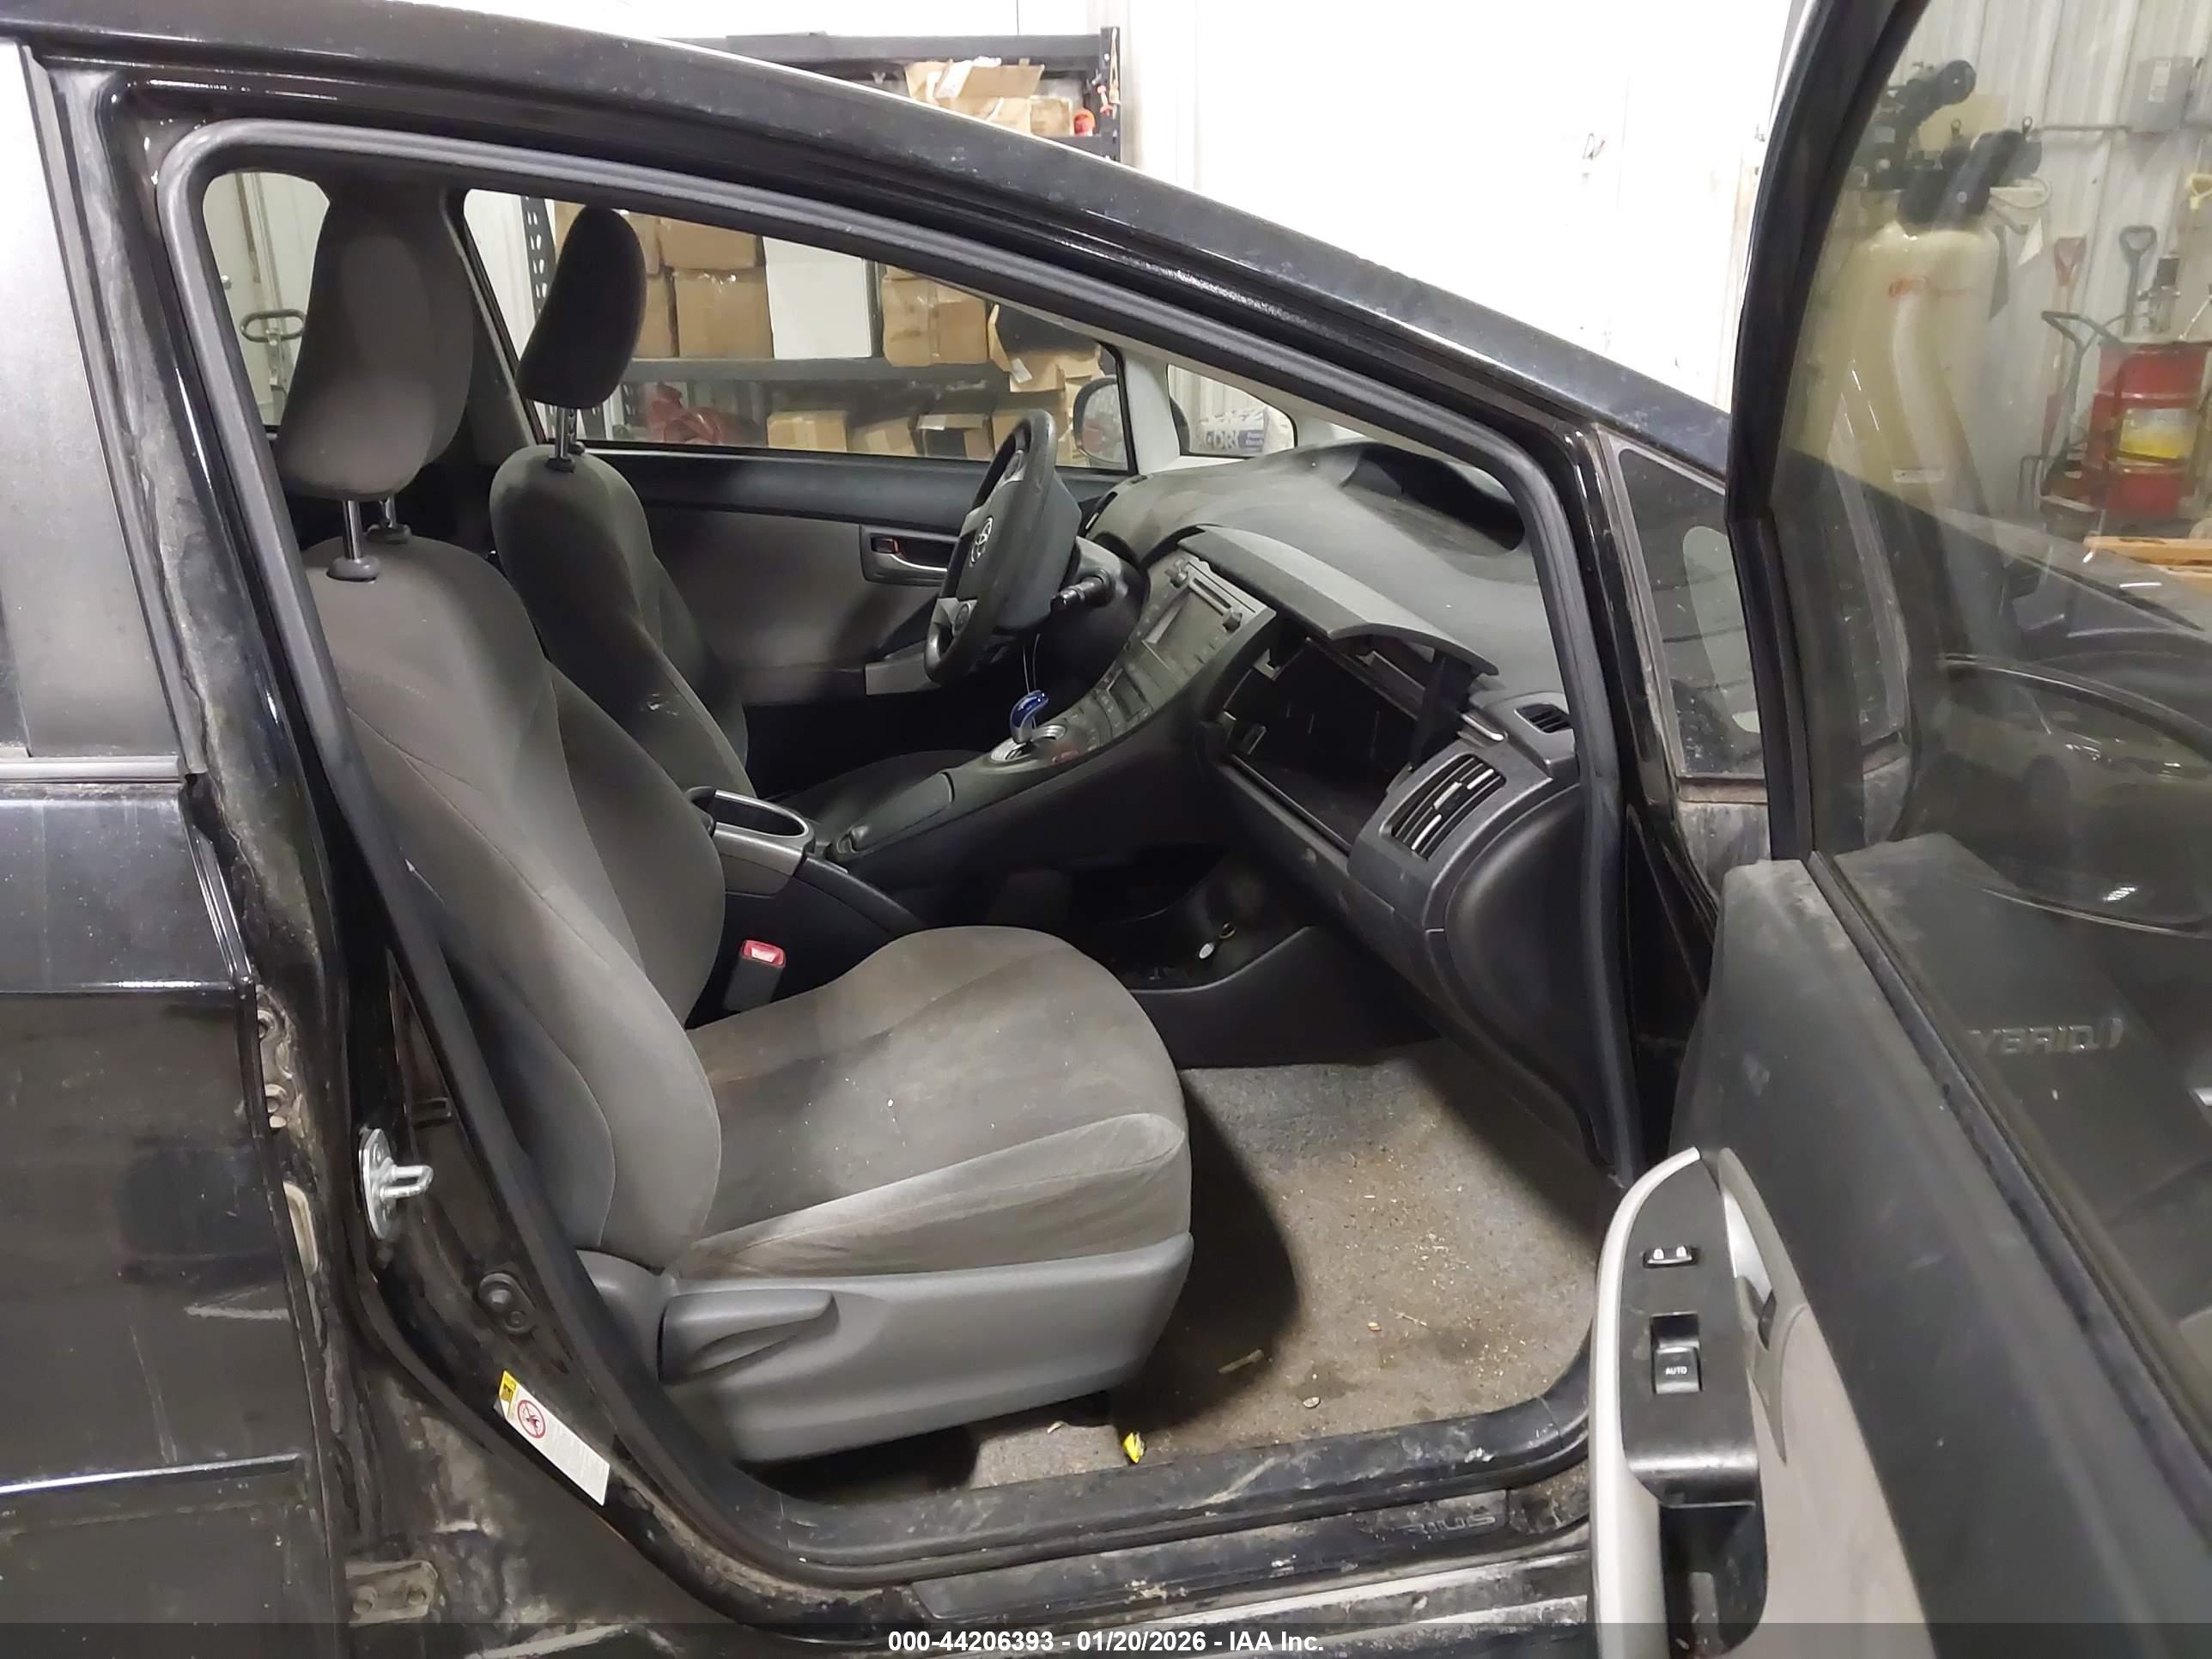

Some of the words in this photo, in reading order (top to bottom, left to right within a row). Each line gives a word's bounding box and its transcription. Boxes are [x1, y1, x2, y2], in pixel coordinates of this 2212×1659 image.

[1969, 1024, 2100, 1054] YBRID
[1665, 1365, 1688, 1375] AUTO
[1397, 1512, 1497, 1534] RIUS
